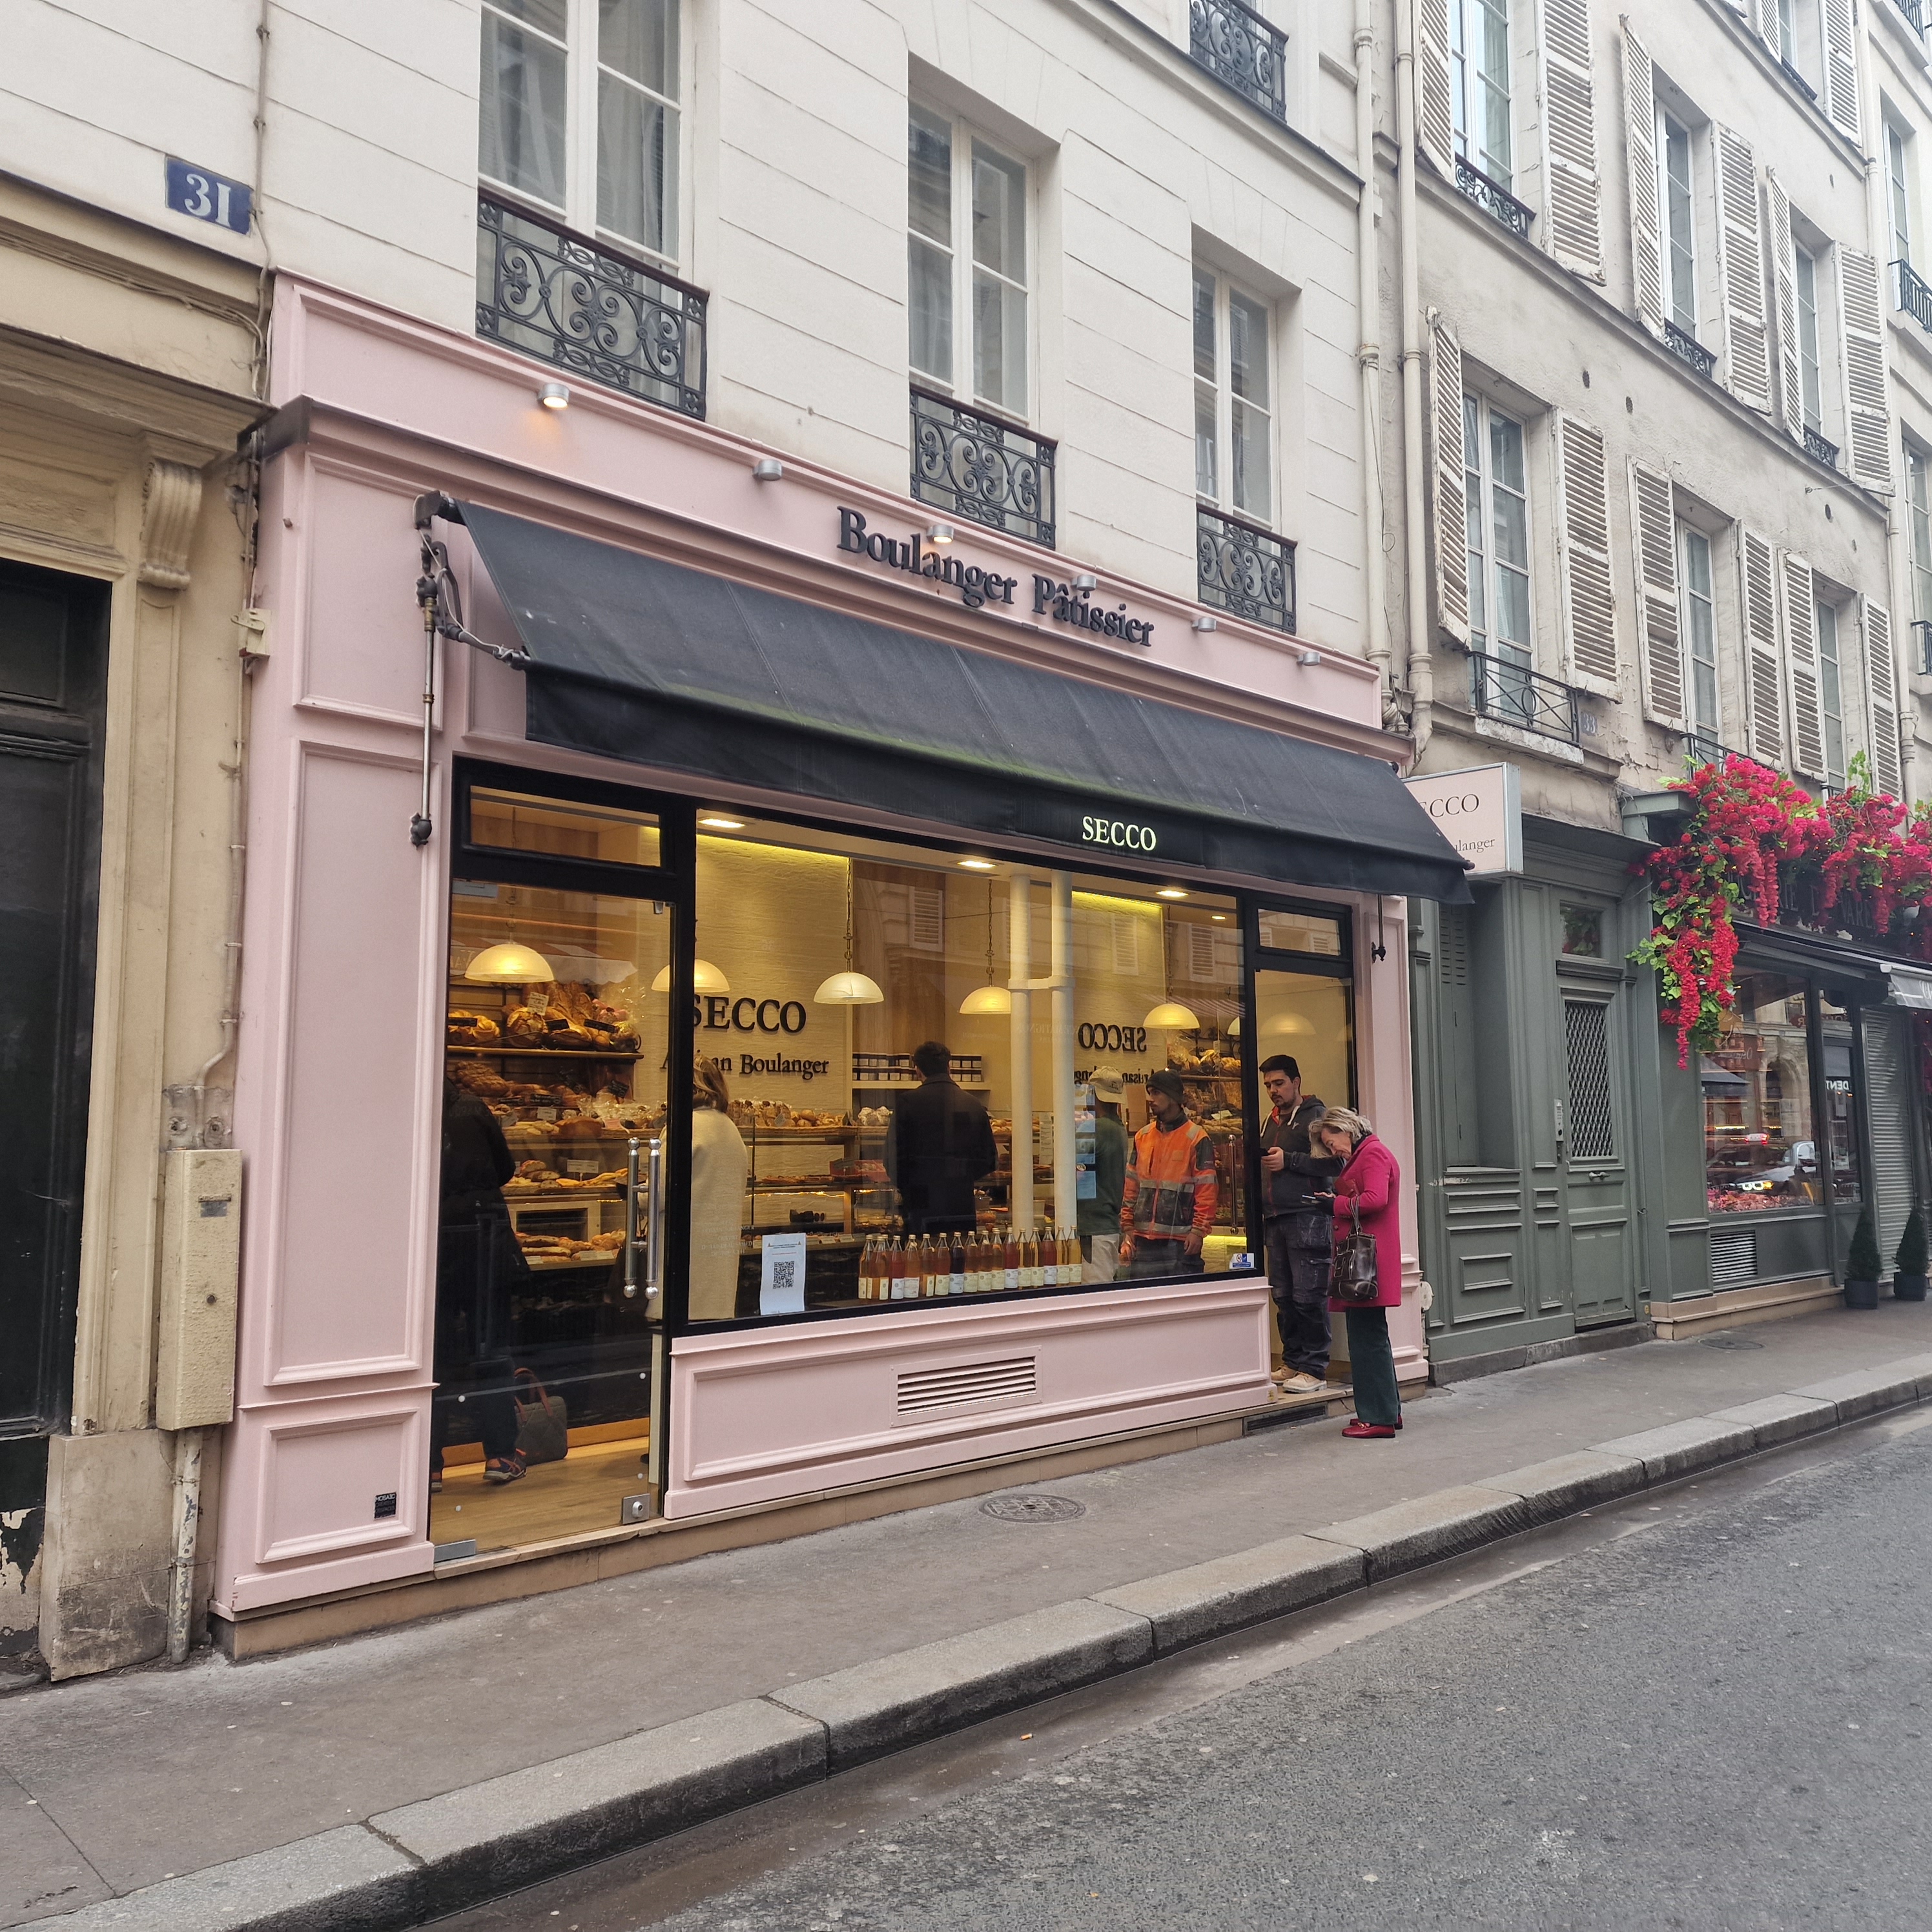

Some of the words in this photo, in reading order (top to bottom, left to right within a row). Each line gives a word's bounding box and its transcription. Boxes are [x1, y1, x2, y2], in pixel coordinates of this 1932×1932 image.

[183, 173, 231, 228] 31
[837, 506, 1018, 608] Boulanger
[1032, 573, 1154, 647] Pâtissier
[1583, 712, 1596, 734] 33
[1419, 794, 1479, 817] CCO
[1082, 816, 1156, 851] SECCO
[1455, 839, 1495, 853] langer
[739, 1053, 829, 1080] Boulanger
